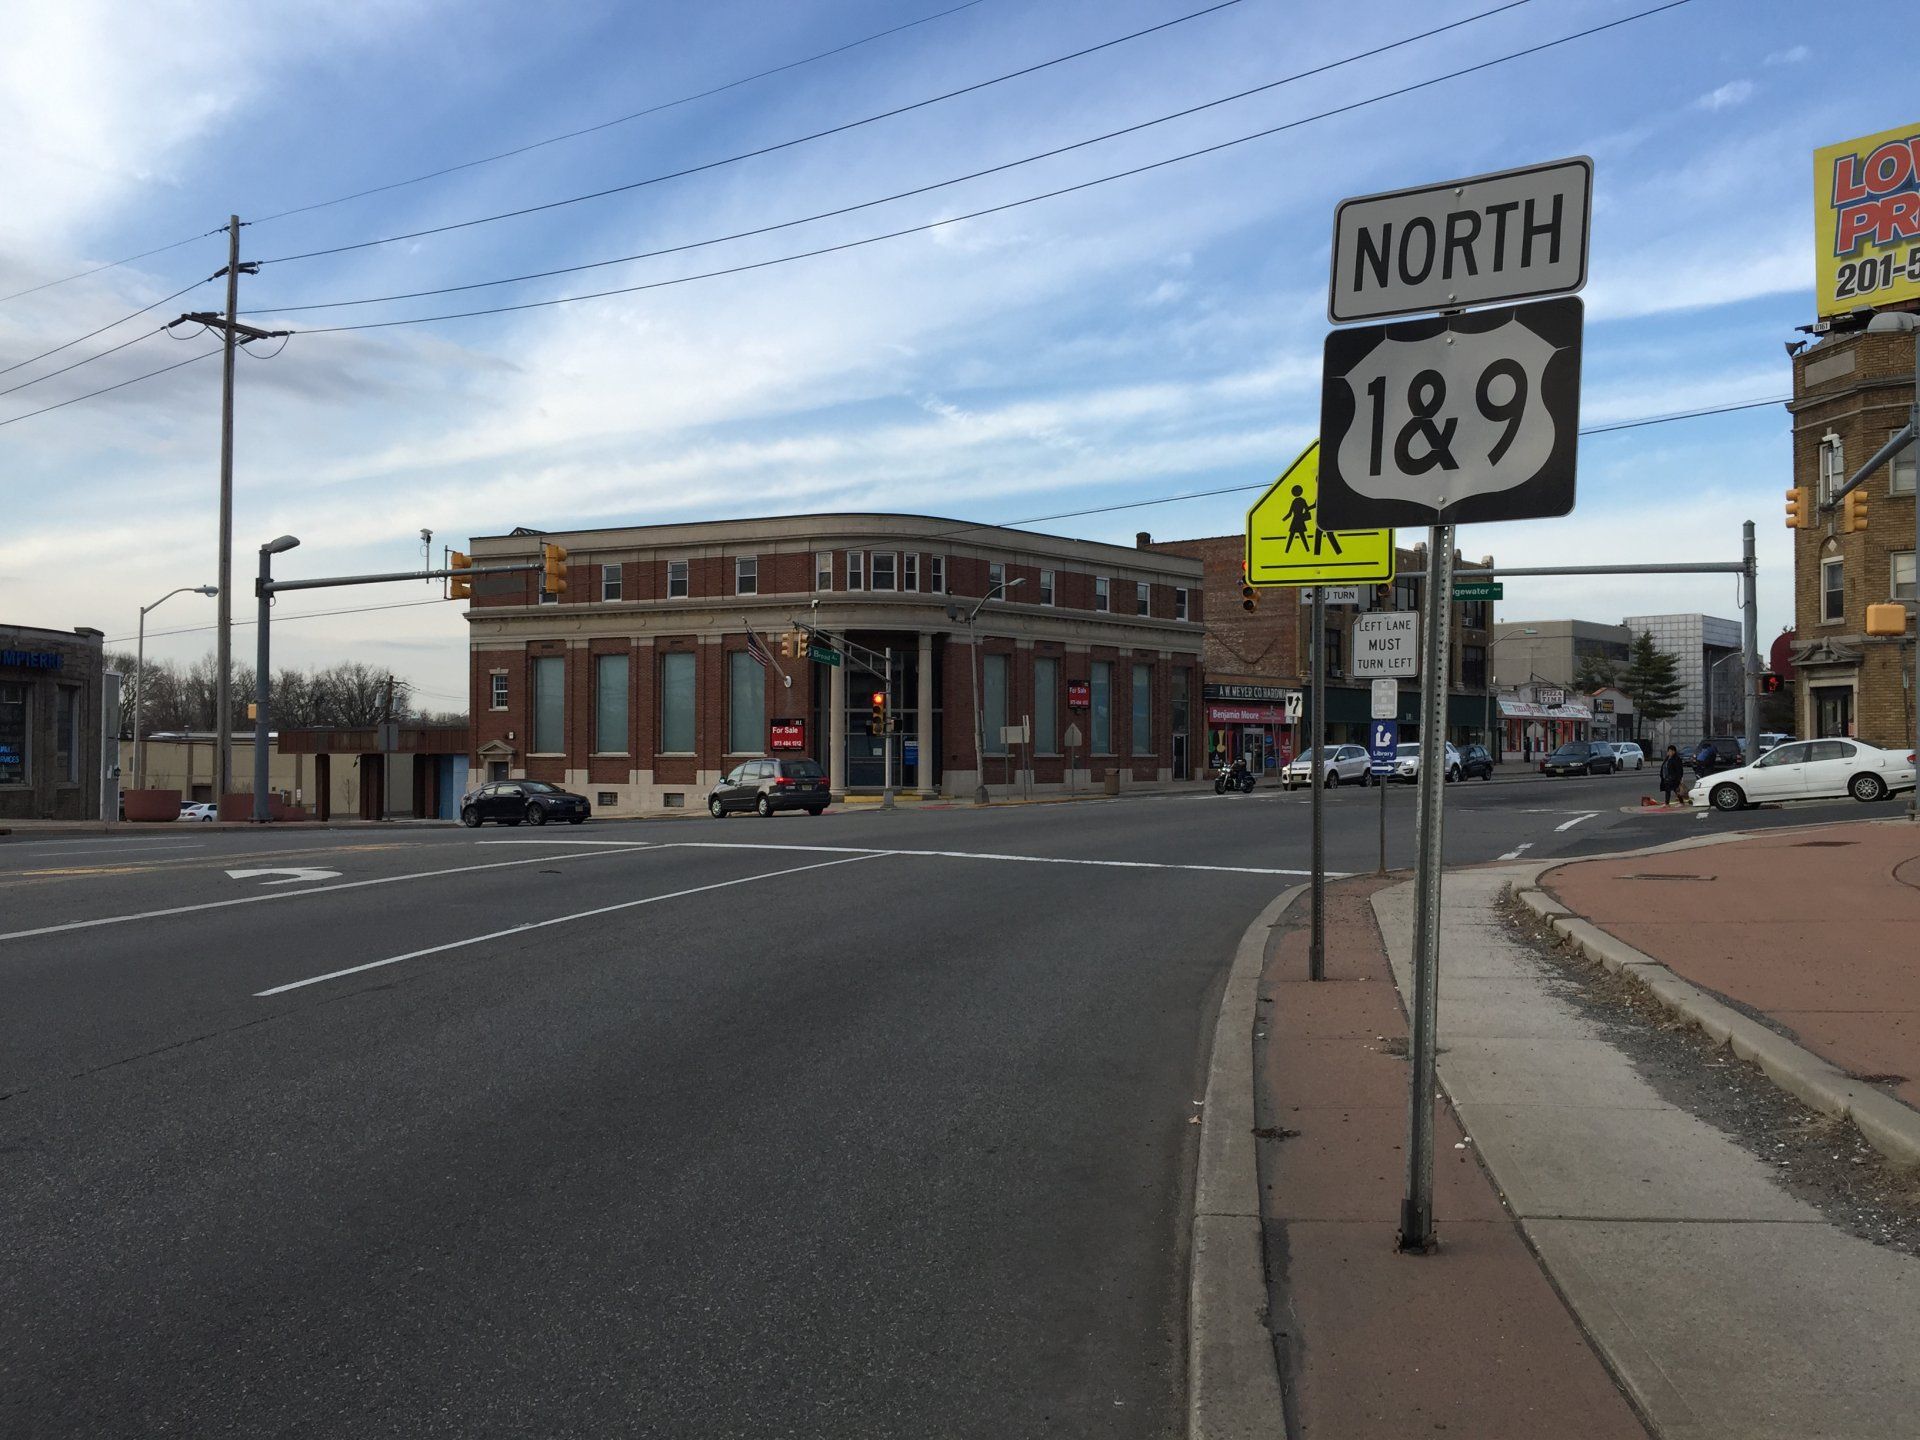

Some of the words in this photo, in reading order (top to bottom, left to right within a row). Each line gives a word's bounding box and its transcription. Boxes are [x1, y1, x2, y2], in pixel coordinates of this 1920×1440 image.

[1354, 194, 1564, 292] NORTH
[1334, 591, 1355, 600] TURN
[1452, 588, 1489, 597] gewater
[1359, 621, 1382, 631] LEFT
[1386, 620, 1411, 631] LANE
[1368, 638, 1401, 651] MUST
[1357, 659, 1383, 669] TURN
[1388, 657, 1412, 668] LEFT
[1212, 709, 1240, 721] Benjamin
[1241, 711, 1259, 720] Moore
[772, 726, 783, 734] For
[784, 726, 799, 734] Sale
[1373, 750, 1394, 758] Library
